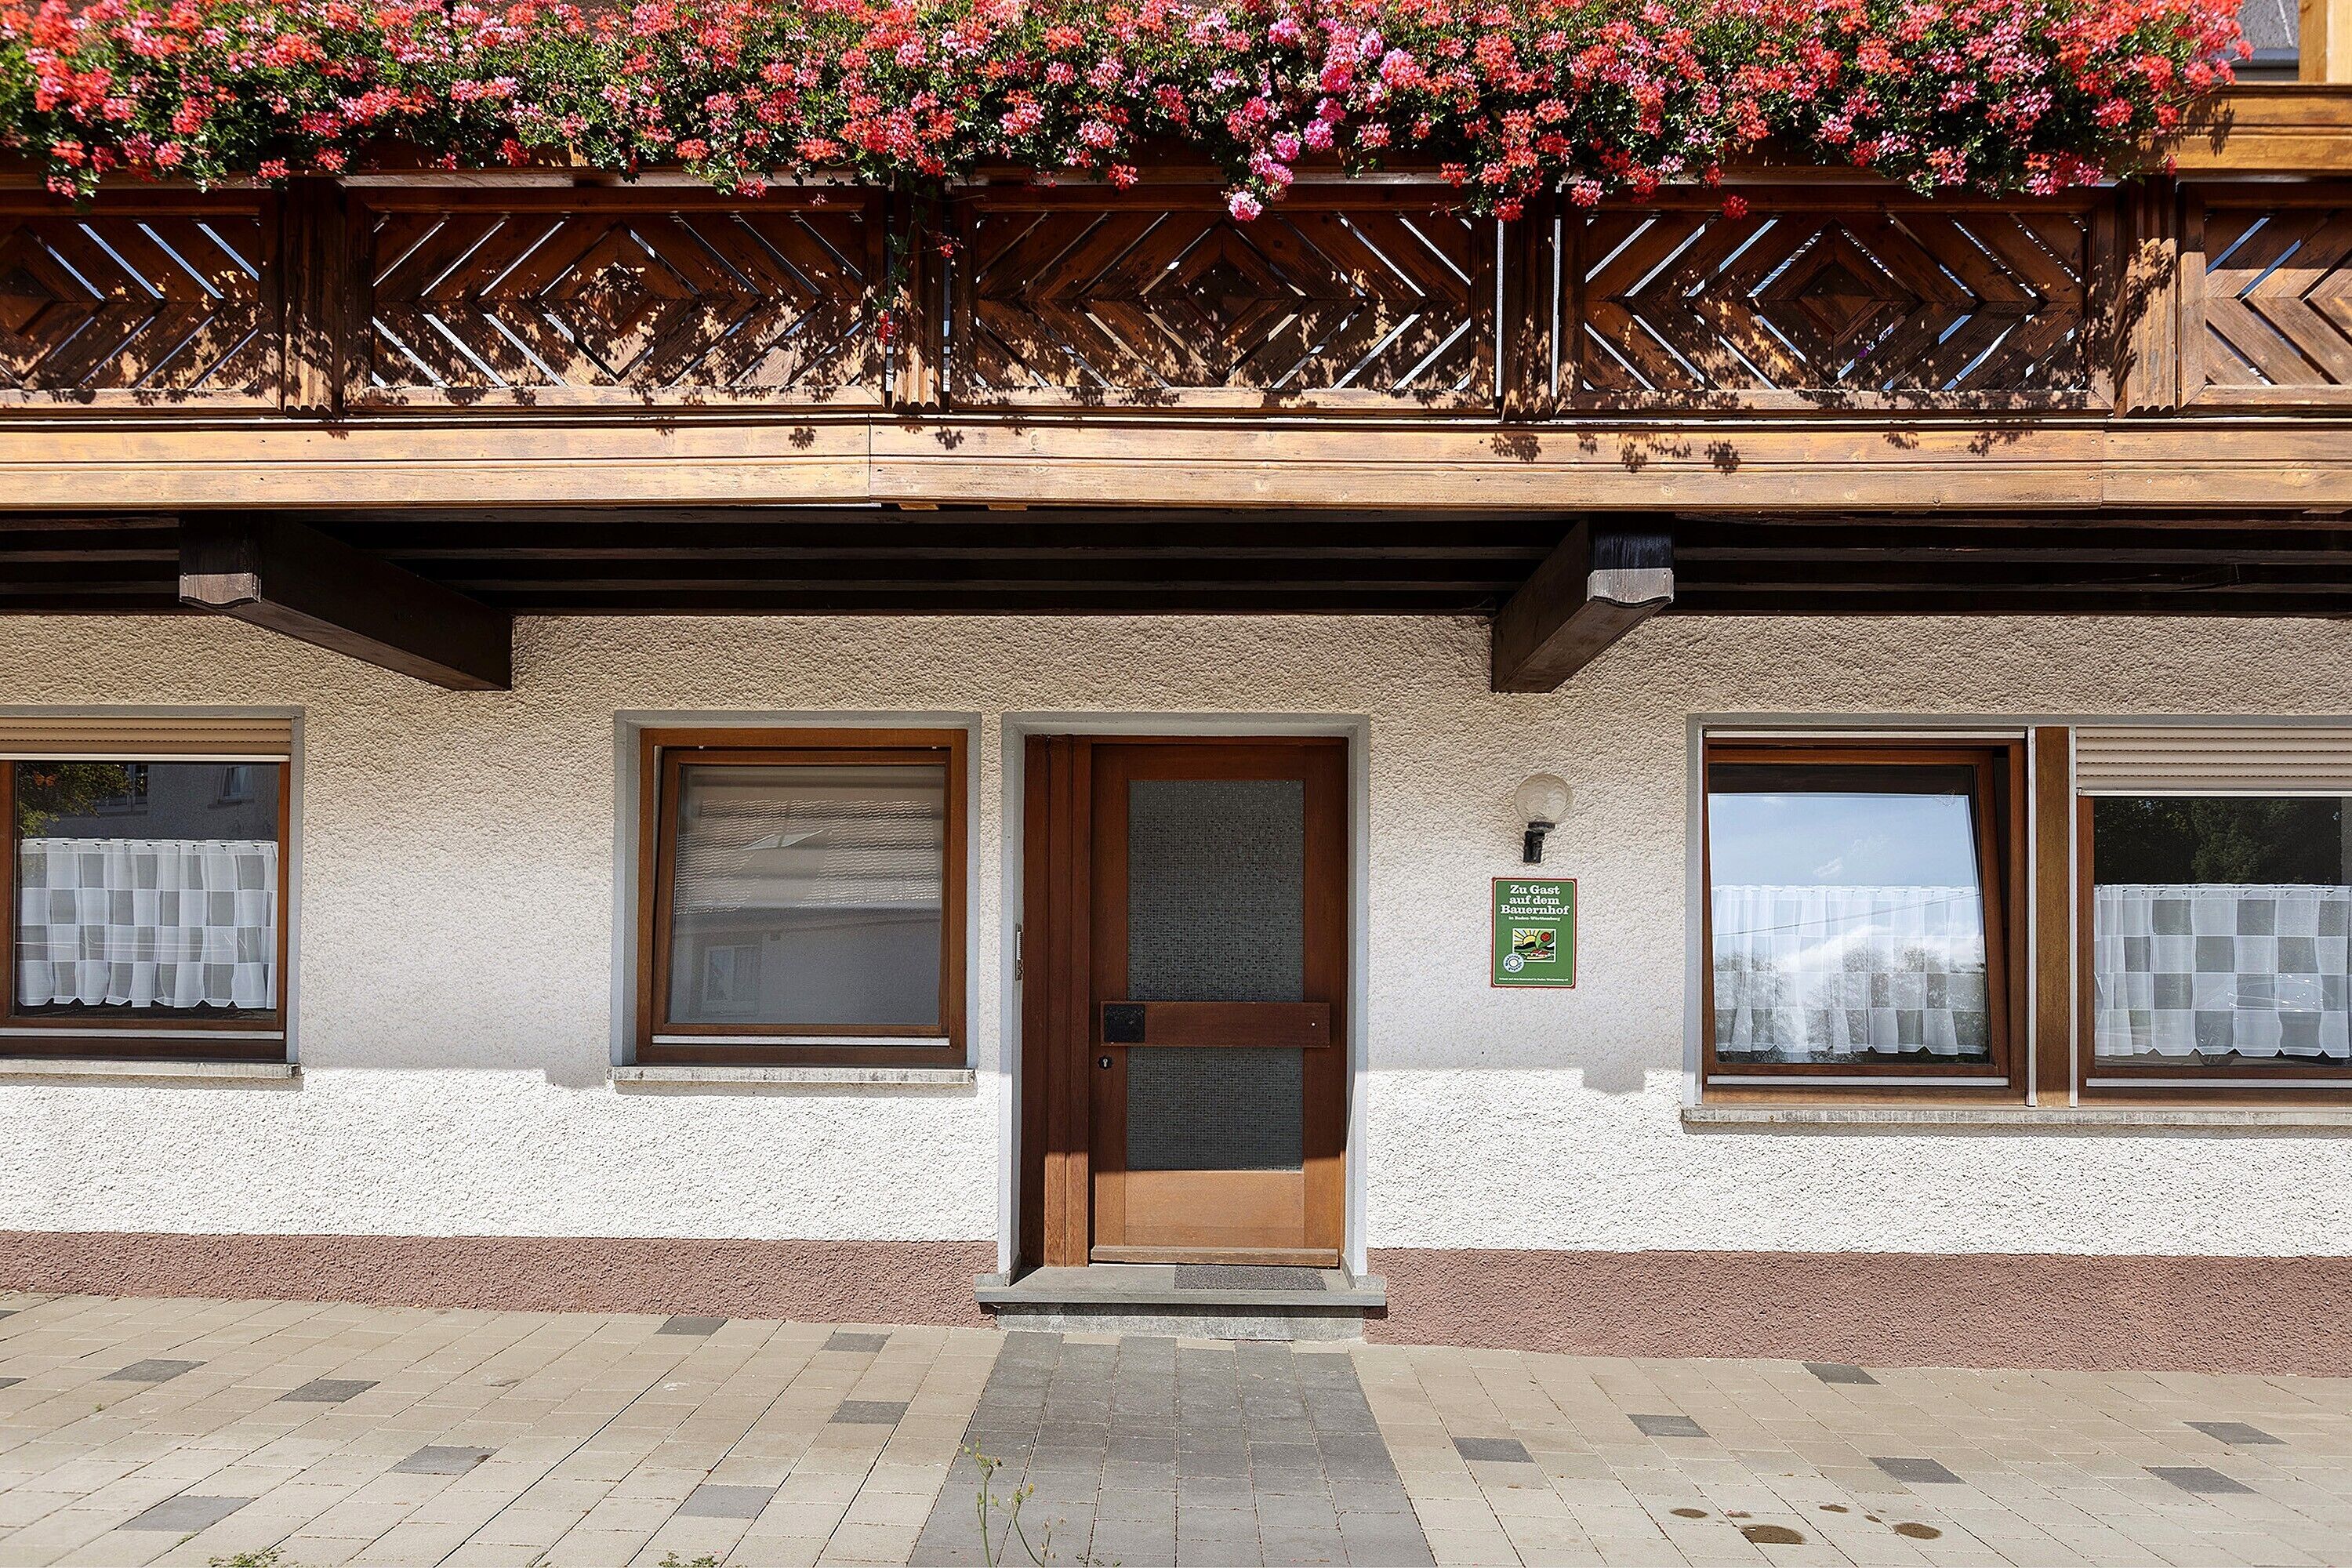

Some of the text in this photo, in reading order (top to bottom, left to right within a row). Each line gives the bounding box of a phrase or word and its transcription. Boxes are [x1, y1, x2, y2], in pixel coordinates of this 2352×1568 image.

[1510, 884, 1560, 895] Zu Gast
[1509, 895, 1560, 905] auf dem
[1501, 905, 1570, 914] Bauernhof
